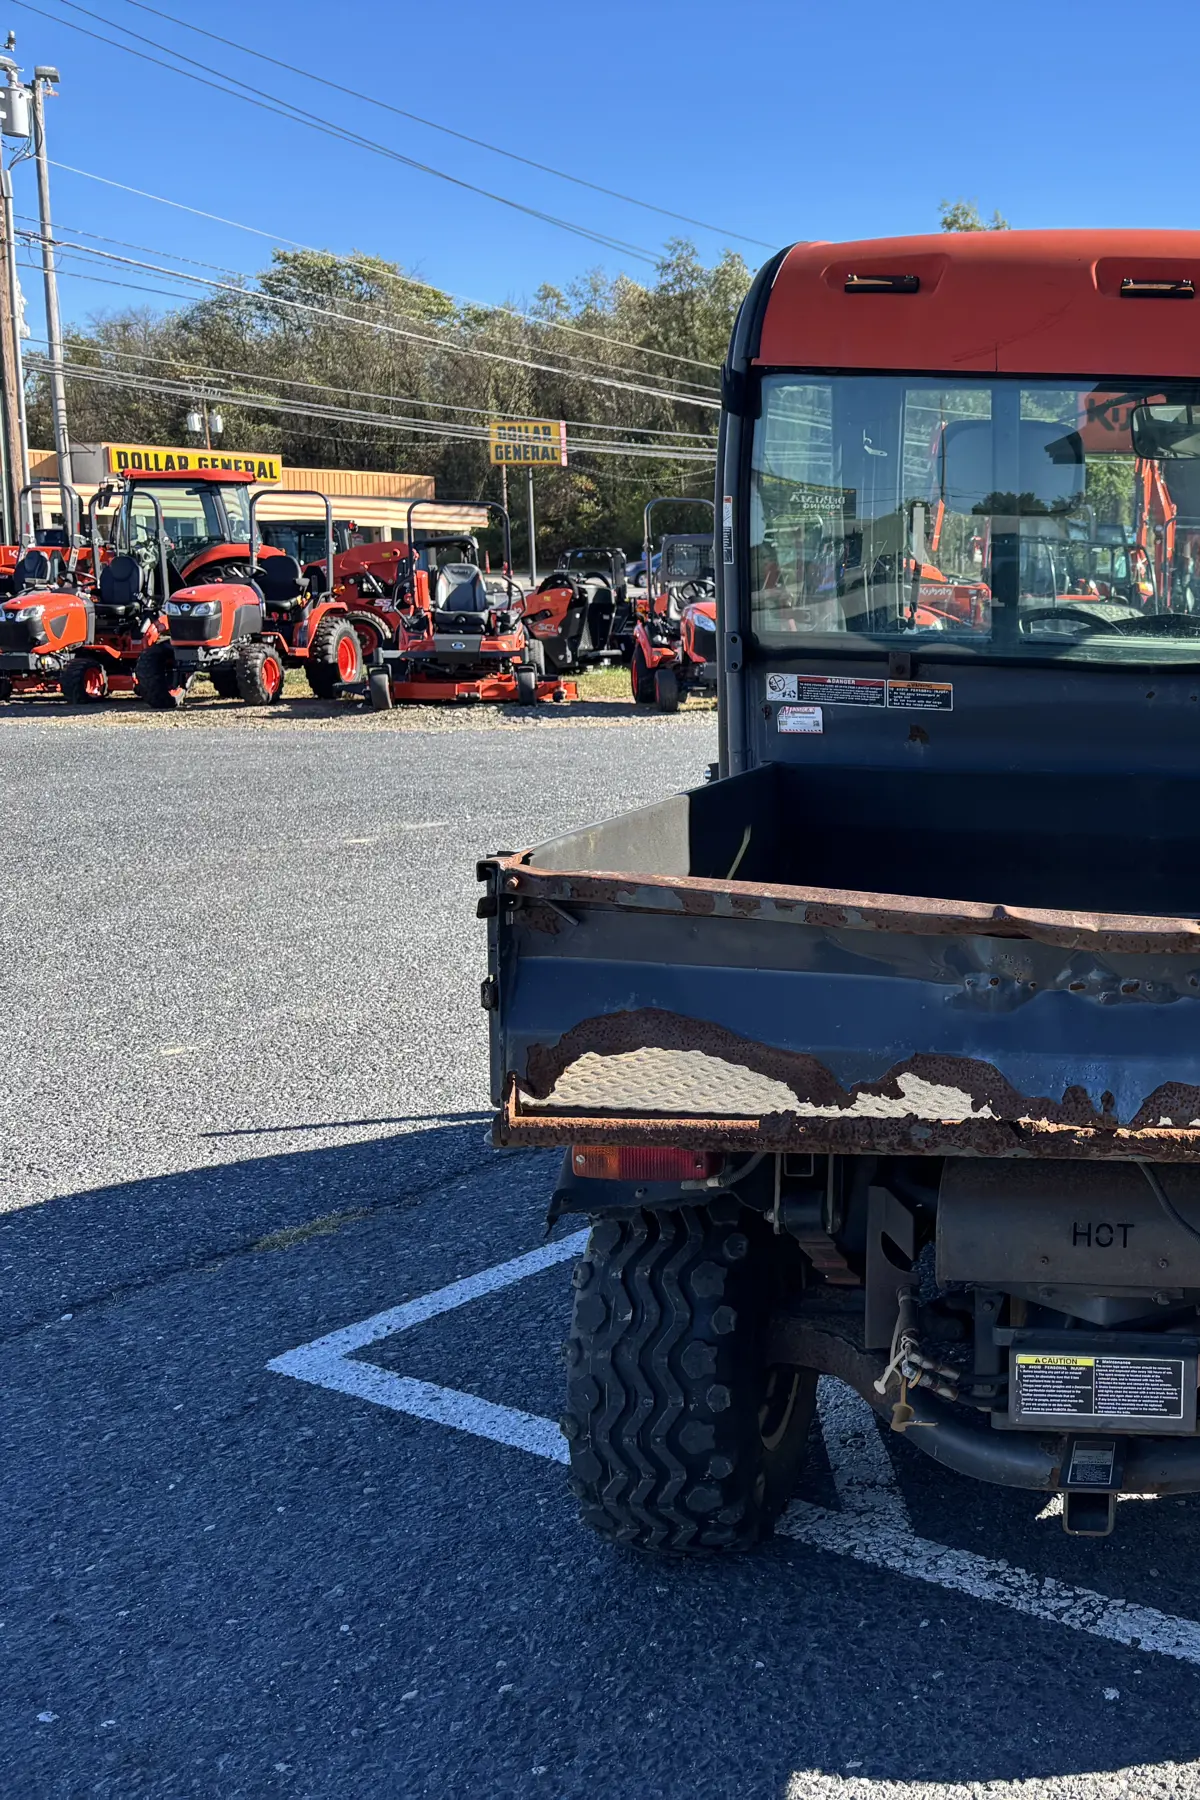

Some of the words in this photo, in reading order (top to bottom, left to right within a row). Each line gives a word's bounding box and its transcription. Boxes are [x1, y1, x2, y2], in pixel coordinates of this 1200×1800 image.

[497, 425, 552, 442] DOLLAR
[495, 444, 558, 460] GENERAL
[116, 451, 189, 472] DOLLAR
[197, 457, 278, 480] GENERAL
[919, 586, 952, 596] Kubota
[1073, 1222, 1135, 1248] HOT
[1041, 1357, 1078, 1365] CAUTION
